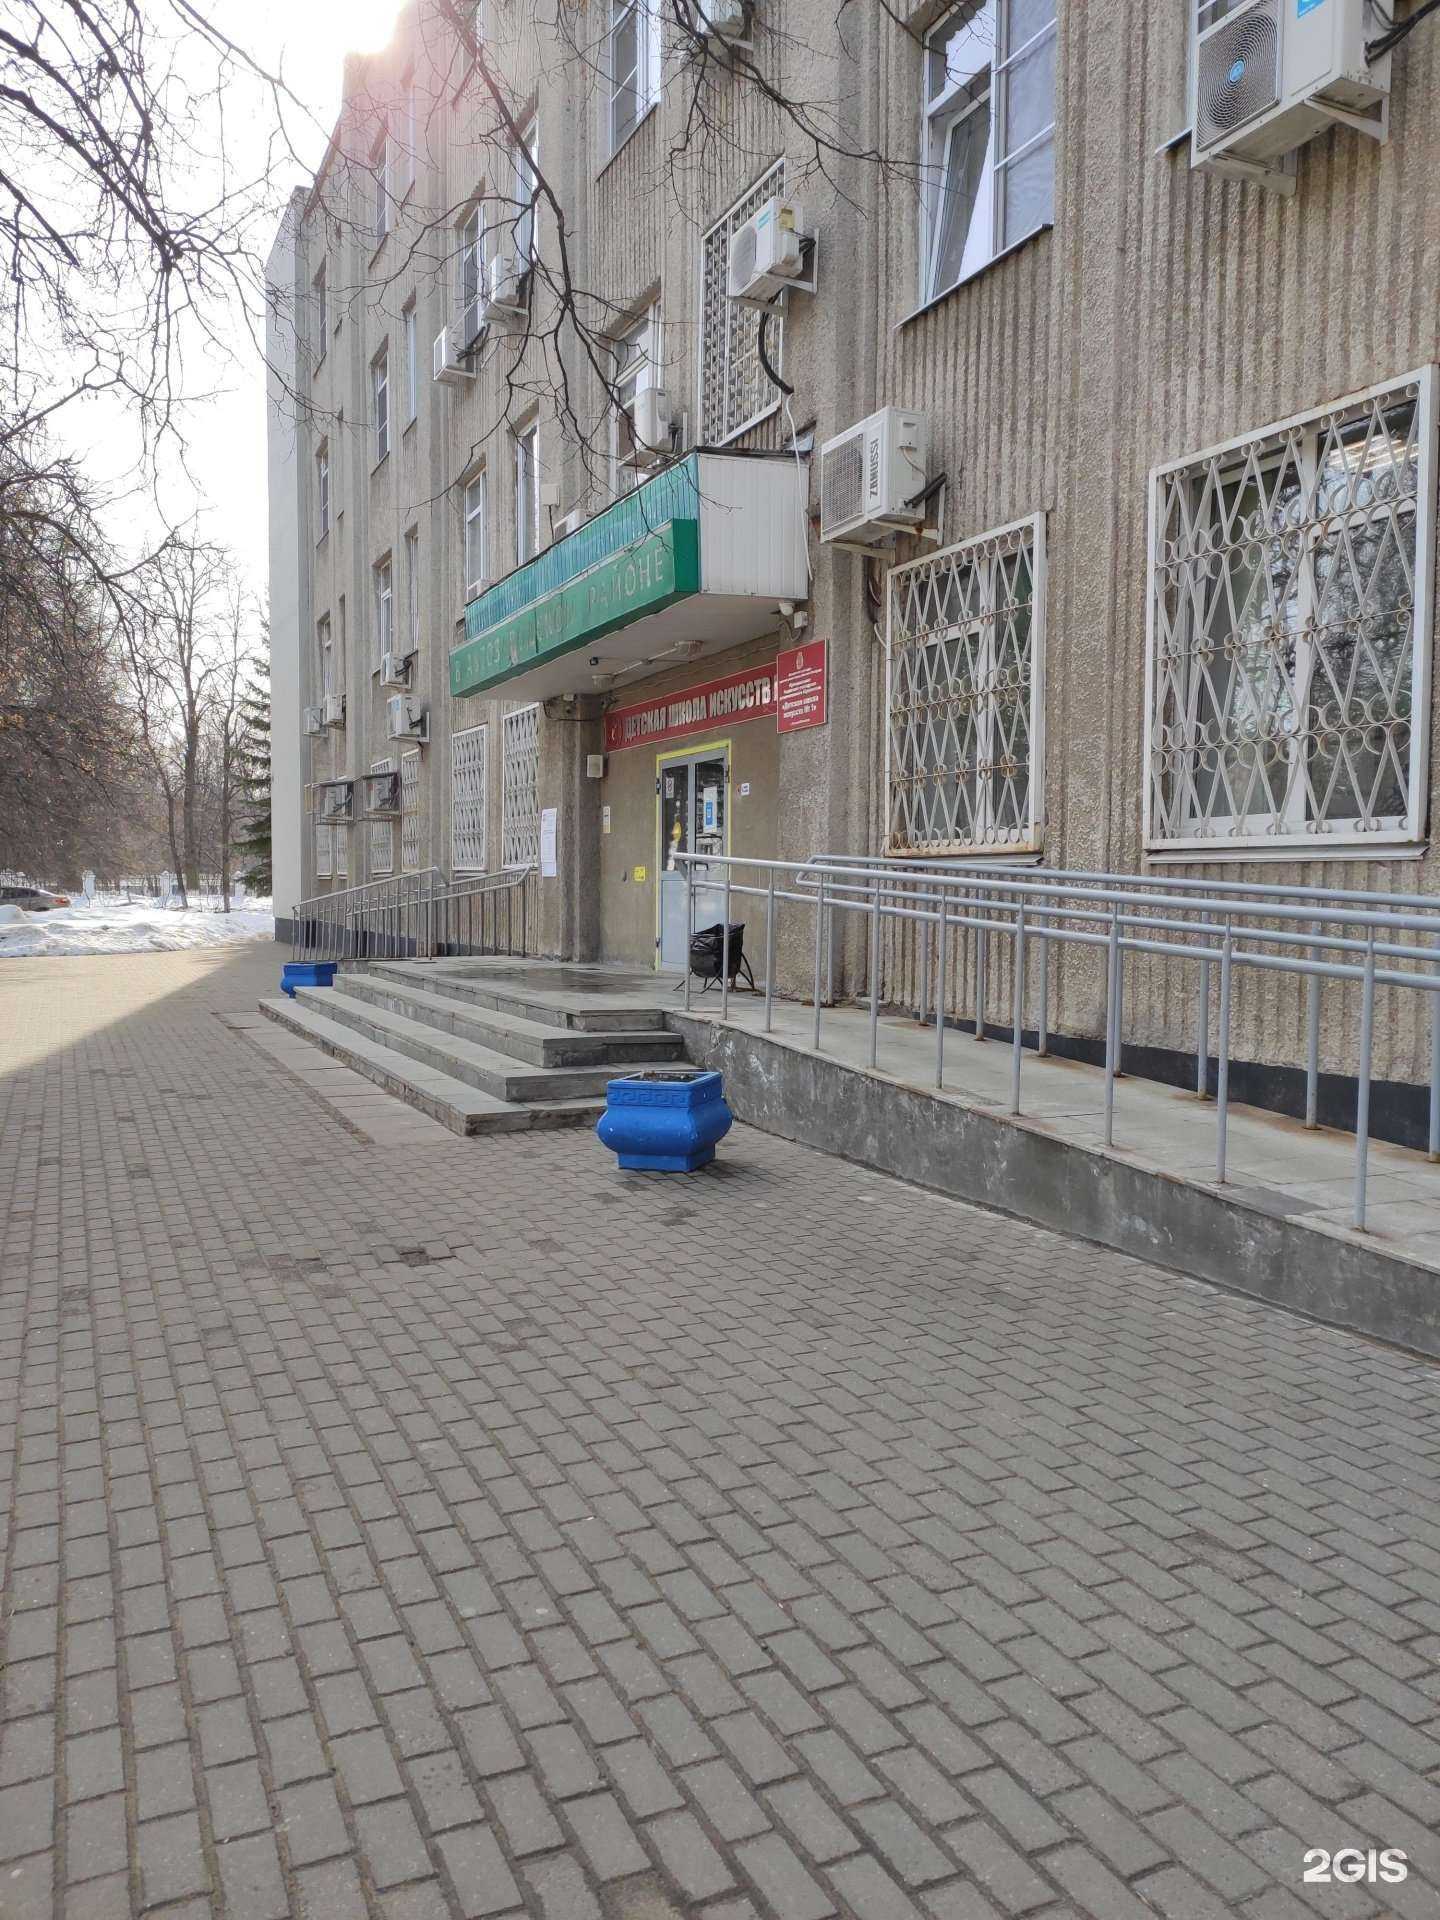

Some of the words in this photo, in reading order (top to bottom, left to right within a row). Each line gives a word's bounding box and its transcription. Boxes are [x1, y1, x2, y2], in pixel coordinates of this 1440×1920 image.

[870, 441, 879, 500] ZANUSSI
[587, 545, 663, 611] РАЙОНЕ
[625, 709, 666, 741] ДЕТСКАЯ
[668, 696, 707, 726] ШКОЛА
[709, 679, 770, 717] ИСКУССТВ
